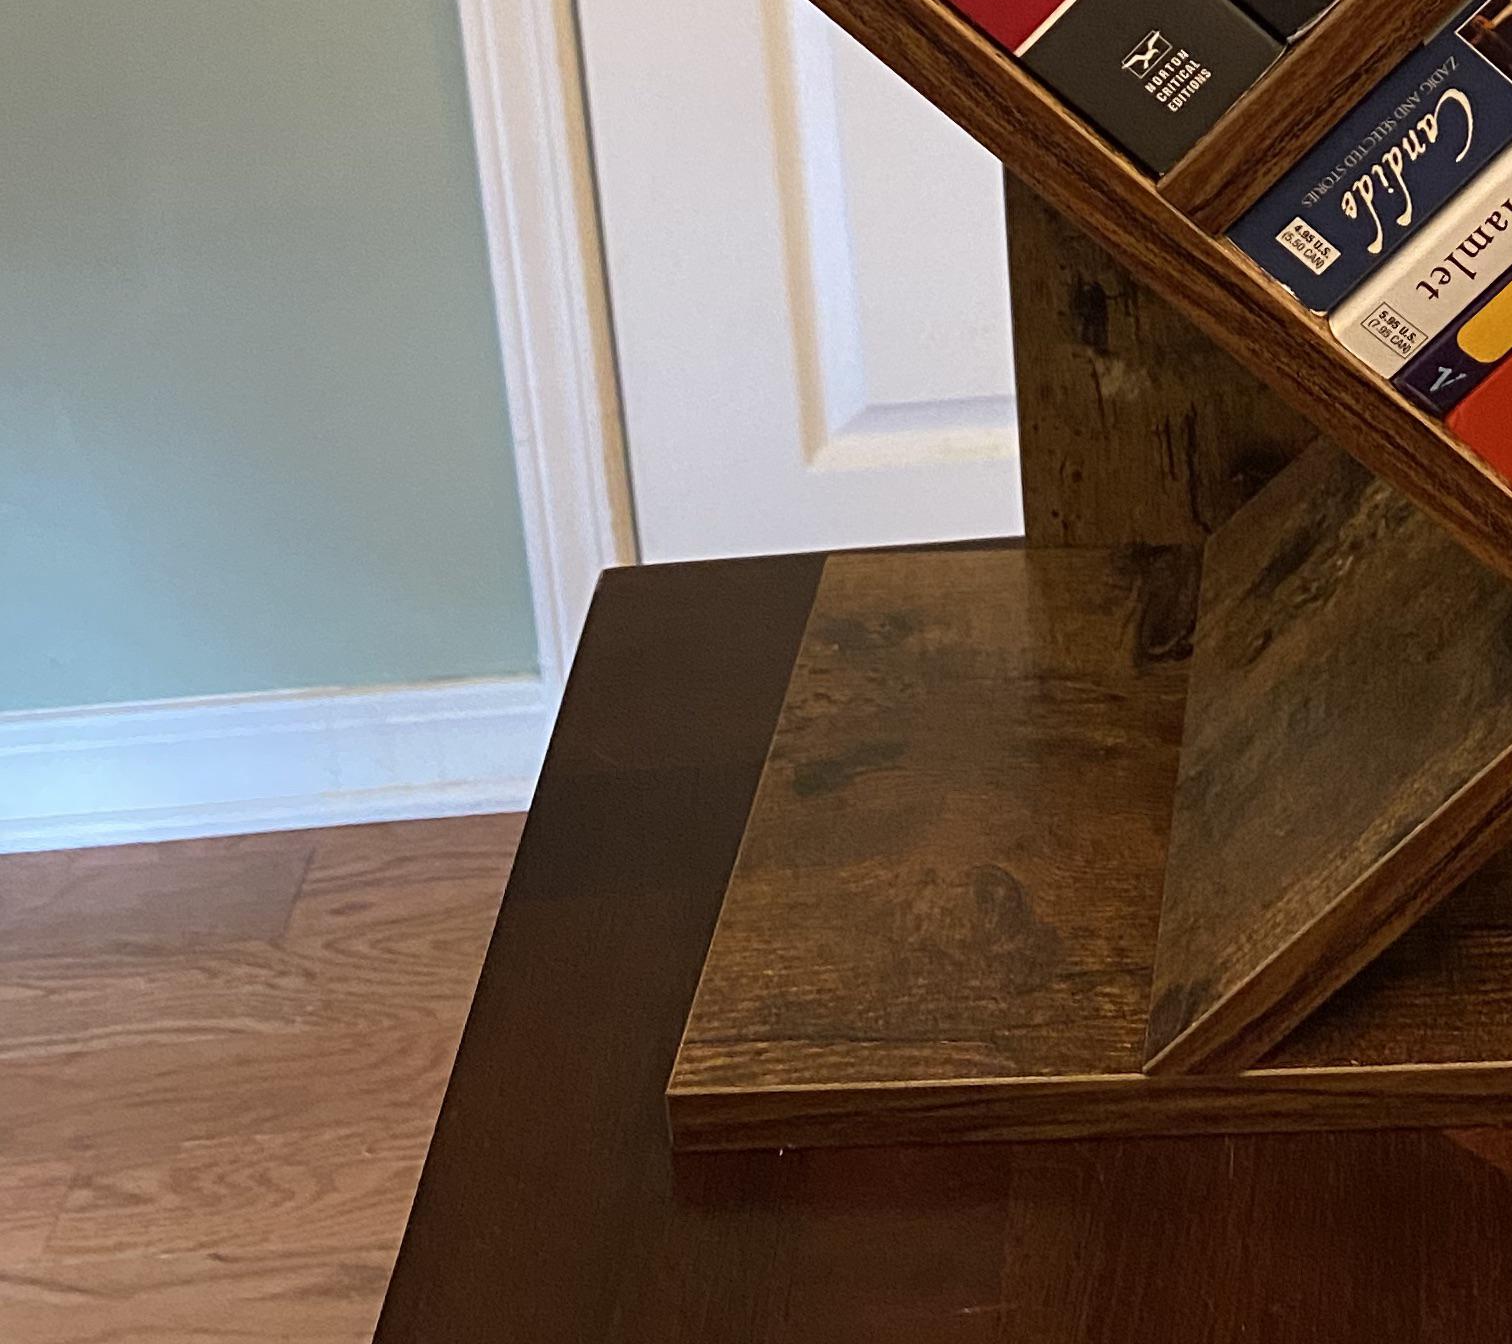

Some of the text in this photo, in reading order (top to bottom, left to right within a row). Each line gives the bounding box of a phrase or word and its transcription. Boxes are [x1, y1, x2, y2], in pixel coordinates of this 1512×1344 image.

[1144, 49, 1189, 98] NORTON
[1156, 60, 1201, 108] CRITICAL
[1167, 68, 1212, 112] EDITIONS
[1297, 55, 1460, 208] ZADIG AND SELECTED STORIES
[1341, 88, 1474, 254] Candide
